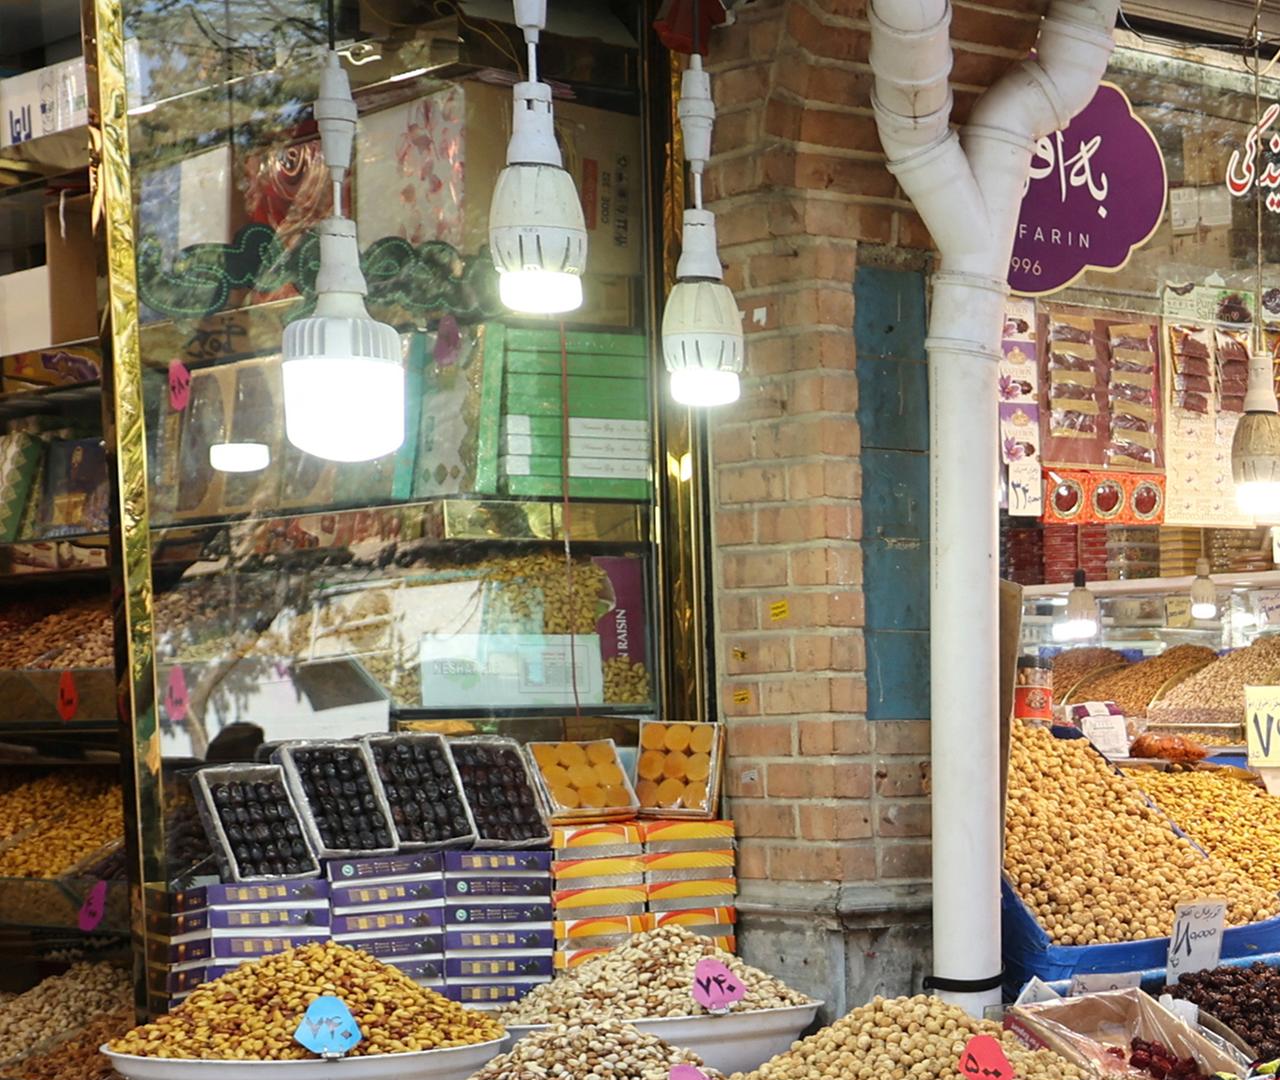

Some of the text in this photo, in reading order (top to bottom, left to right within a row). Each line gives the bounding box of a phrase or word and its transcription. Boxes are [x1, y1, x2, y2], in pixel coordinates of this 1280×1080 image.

[1019, 223, 1091, 249] FARIN
[1010, 257, 1043, 276] 996
[616, 608, 628, 653] RAISIN
